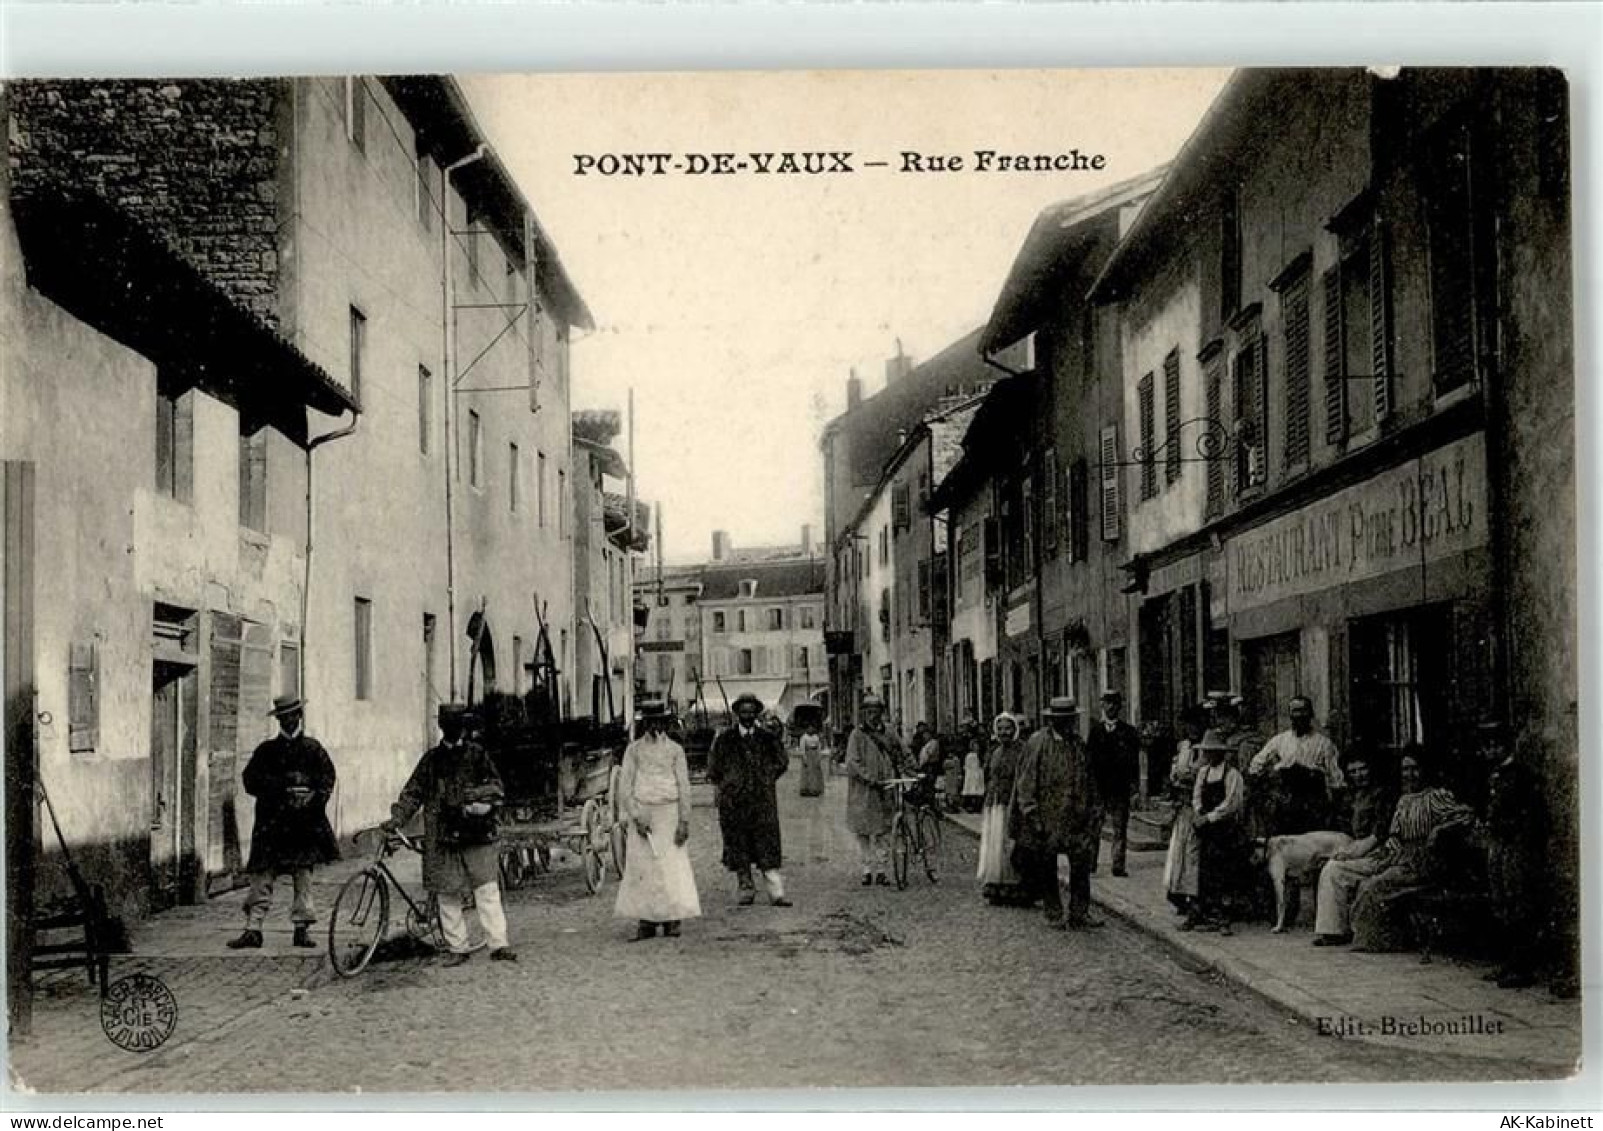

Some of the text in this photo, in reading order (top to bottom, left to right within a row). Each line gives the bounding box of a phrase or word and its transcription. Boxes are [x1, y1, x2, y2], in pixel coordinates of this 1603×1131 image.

[573, 152, 854, 177] PONT-DE-VAUX
[900, 152, 964, 173] Rue
[973, 149, 1106, 172] Franche
[1236, 509, 1341, 593] RESTAURANT
[1316, 1014, 1505, 1038] Edit. Brebouillet
